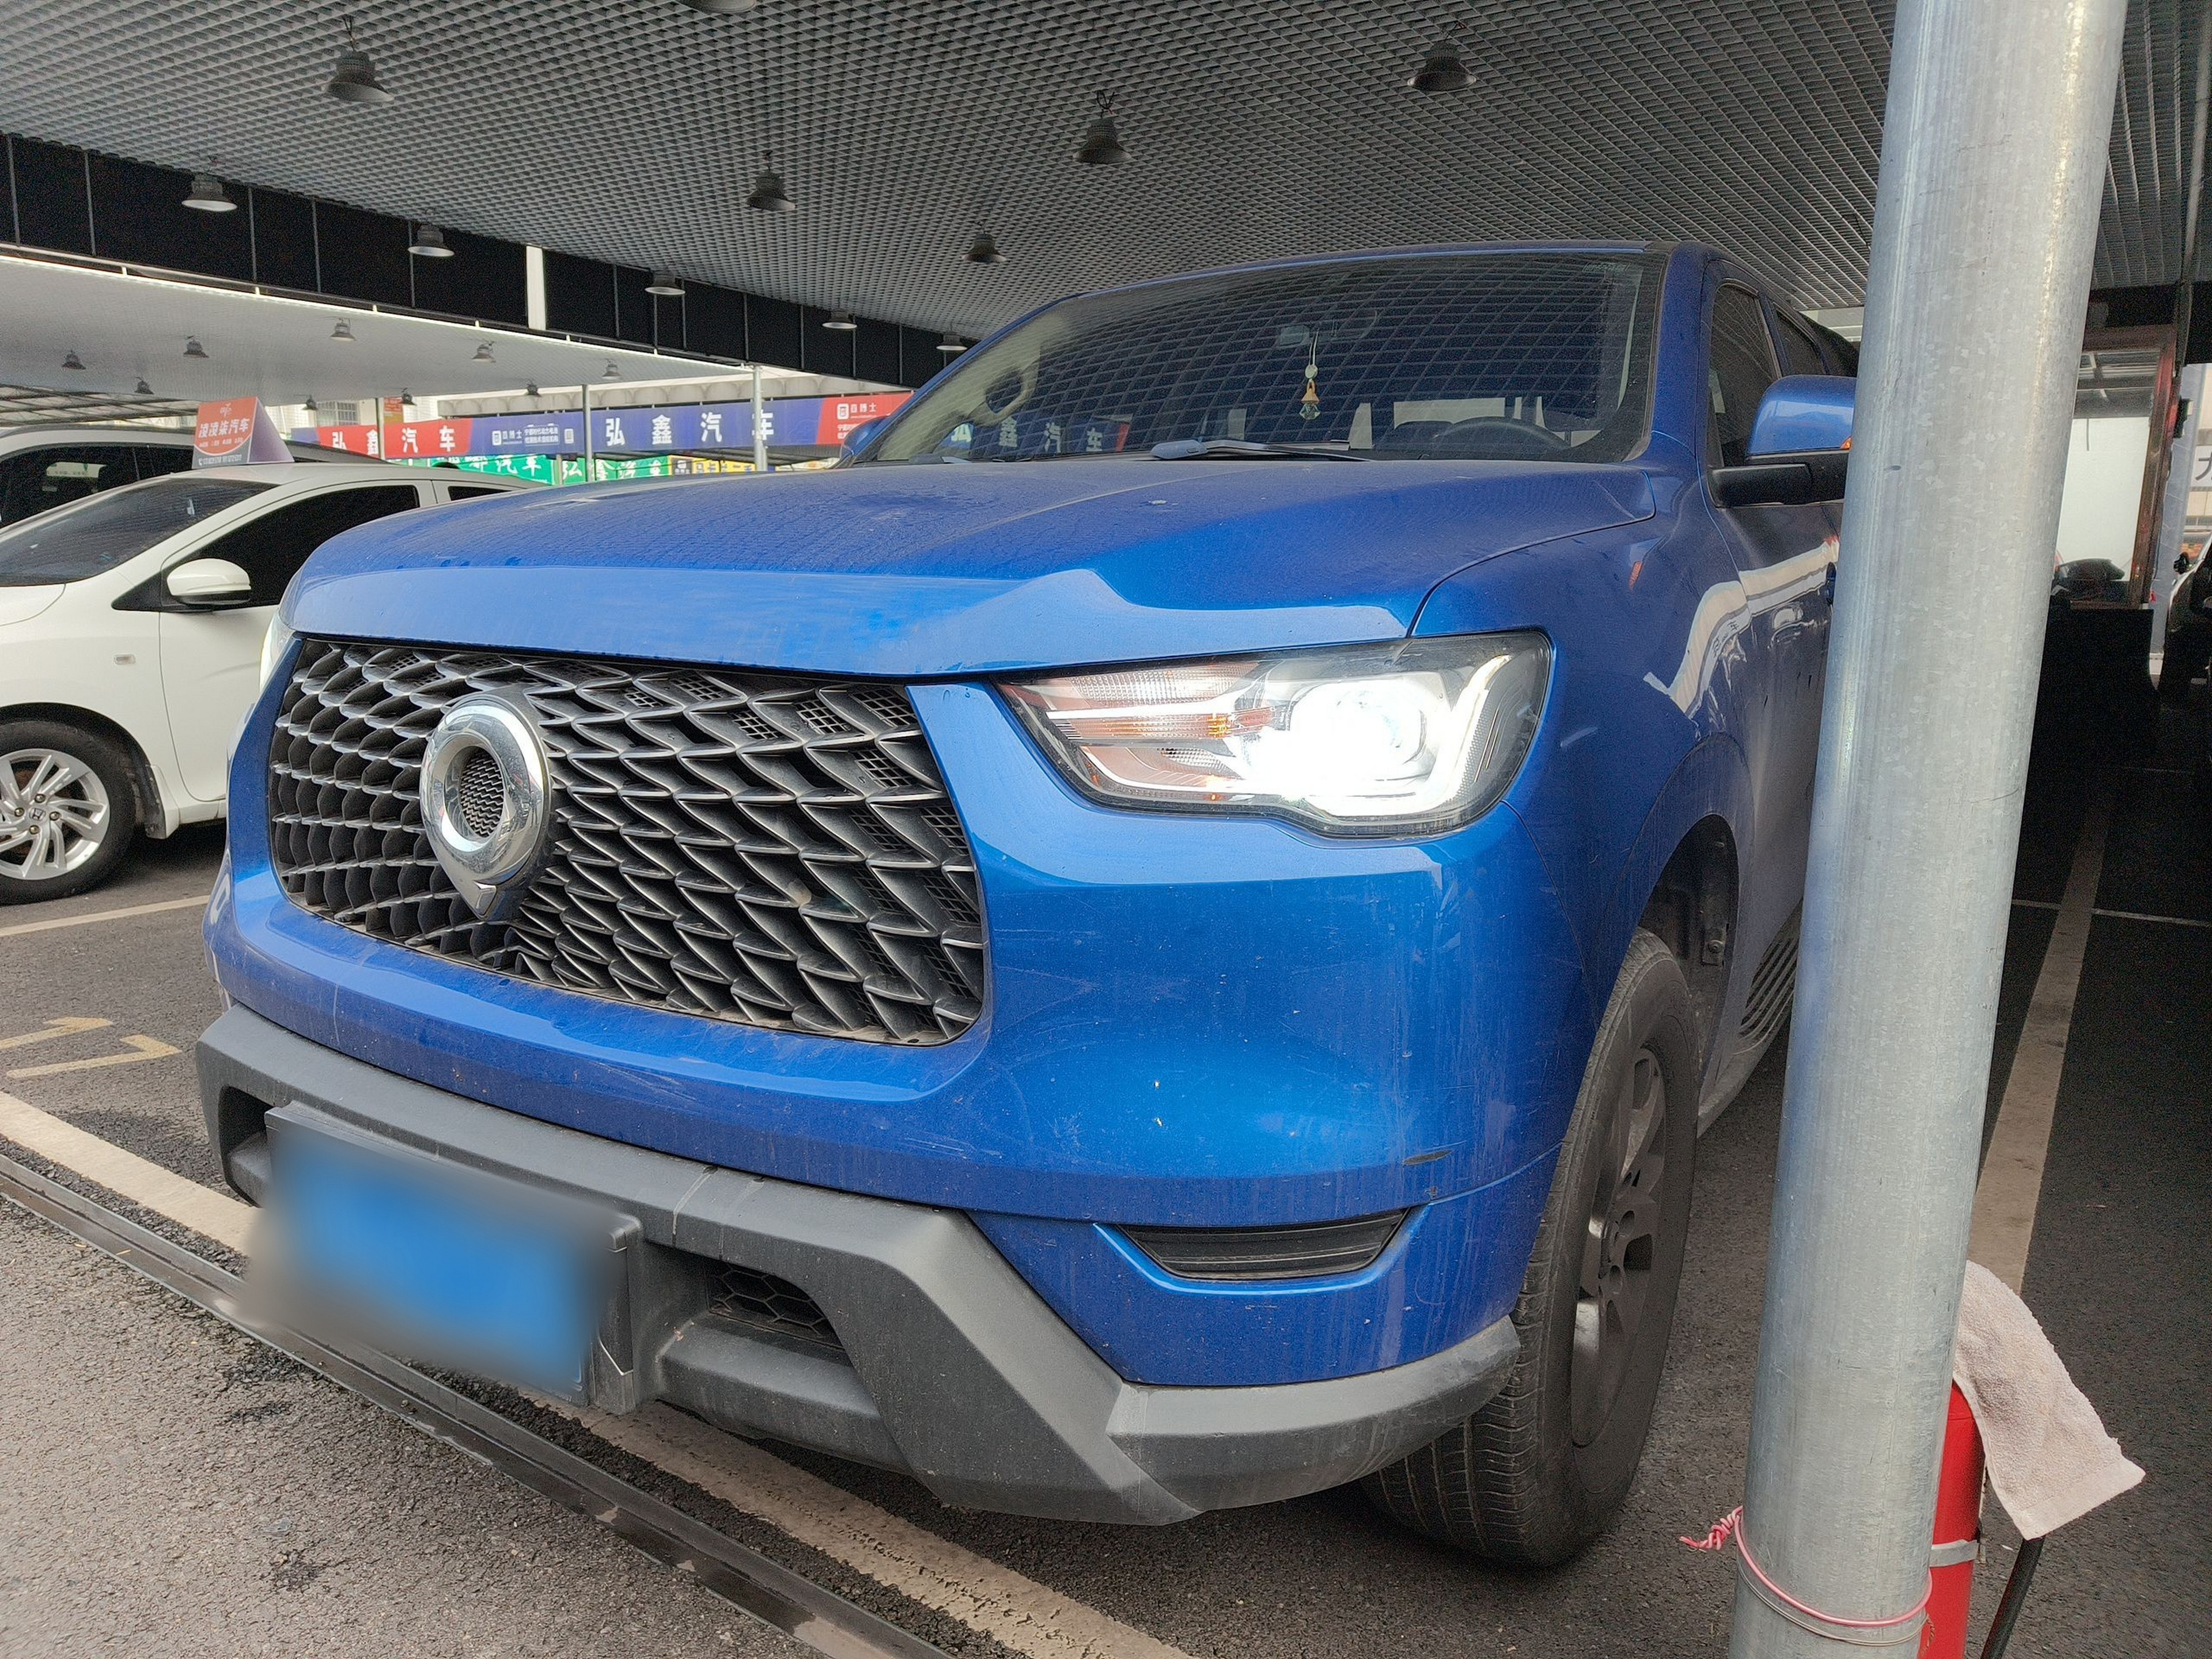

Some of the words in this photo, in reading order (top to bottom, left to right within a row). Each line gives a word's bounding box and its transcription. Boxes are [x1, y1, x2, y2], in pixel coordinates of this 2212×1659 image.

[332, 425, 456, 455] 弘鑫汽车
[605, 410, 774, 446] 弘鑫汽车
